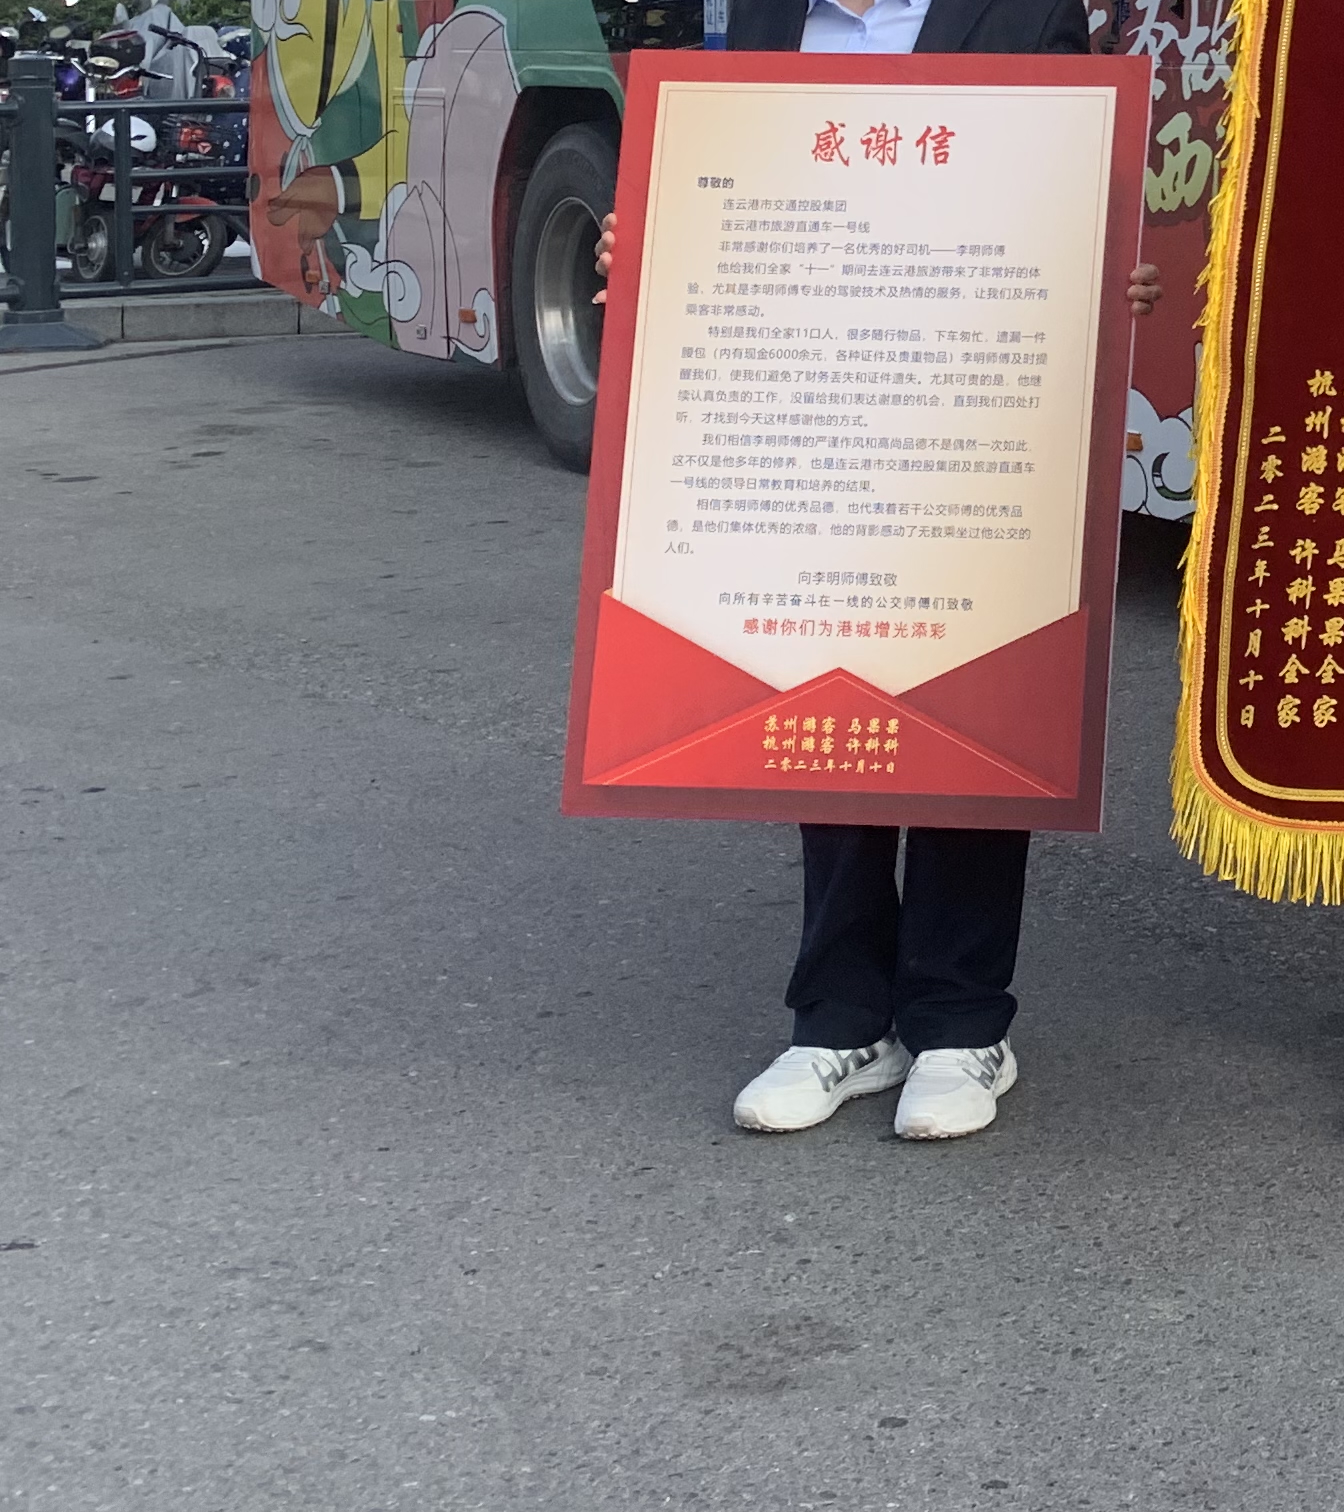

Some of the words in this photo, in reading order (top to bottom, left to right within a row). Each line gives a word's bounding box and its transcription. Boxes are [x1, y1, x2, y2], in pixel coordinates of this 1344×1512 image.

[810, 119, 957, 168] 感谢信
[697, 176, 735, 190] 尊敬的
[721, 197, 848, 214] 连云港市交通控股集团
[720, 218, 871, 235] 连云港市旅游直通车一号线
[684, 303, 766, 319] 乘客非常感动。
[664, 541, 695, 555] 人们。
[797, 570, 898, 587] 向李明师傅致敬
[1239, 425, 1287, 728] 二零二三年十月十日
[718, 591, 974, 612] 向所有辛苦奋斗在一线的公交师傅们致敬
[742, 617, 948, 640] 感谢你们为港城增光添彩
[763, 714, 837, 733] 苏州游客
[847, 716, 901, 736] 马果果
[762, 736, 836, 754] 杭州游客
[845, 736, 900, 756] 许科科
[763, 757, 896, 774] 二零二三年十月十日
